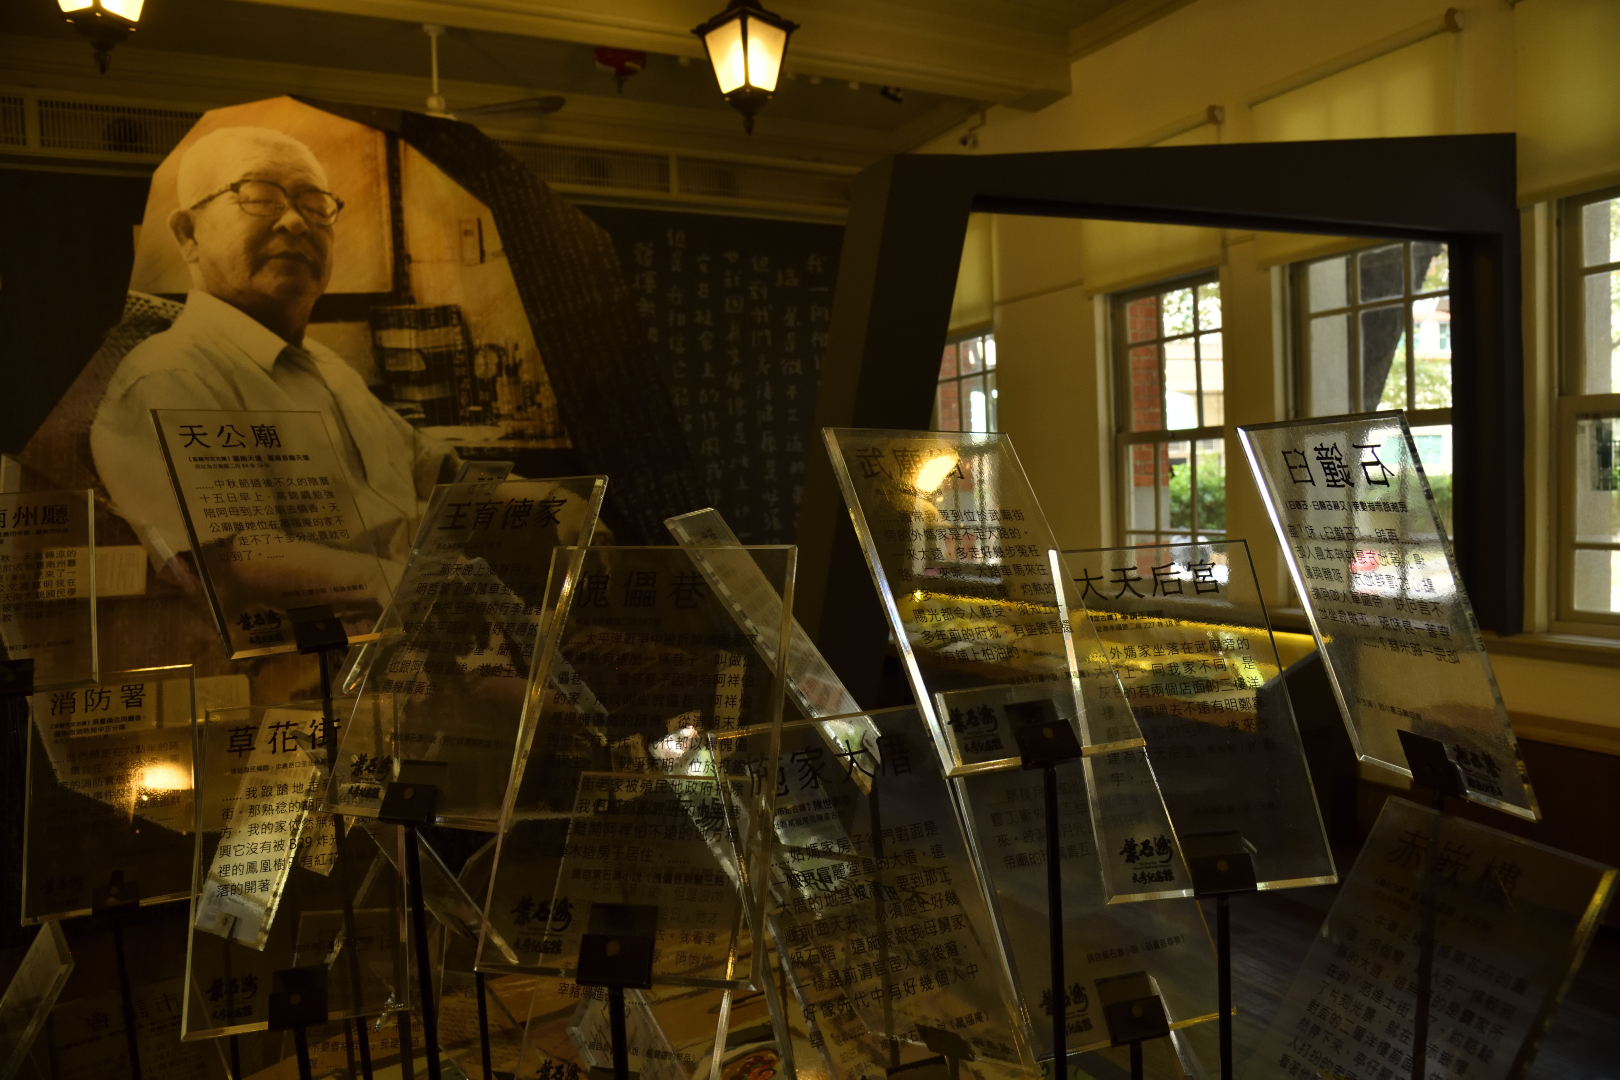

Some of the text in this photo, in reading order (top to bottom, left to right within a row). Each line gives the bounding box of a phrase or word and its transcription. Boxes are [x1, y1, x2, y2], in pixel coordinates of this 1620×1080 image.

[179, 424, 282, 448] 天公廟
[438, 496, 567, 532] 王育德家
[574, 569, 707, 609] 傀儡巷
[1073, 558, 1221, 601] 大天后宮
[50, 683, 147, 717] 消防署
[226, 717, 342, 758] 草花街
[1119, 834, 1174, 864] 葉石濤
[1388, 829, 1524, 900] 赤嵌樓
[510, 895, 575, 933] 葉石濤
